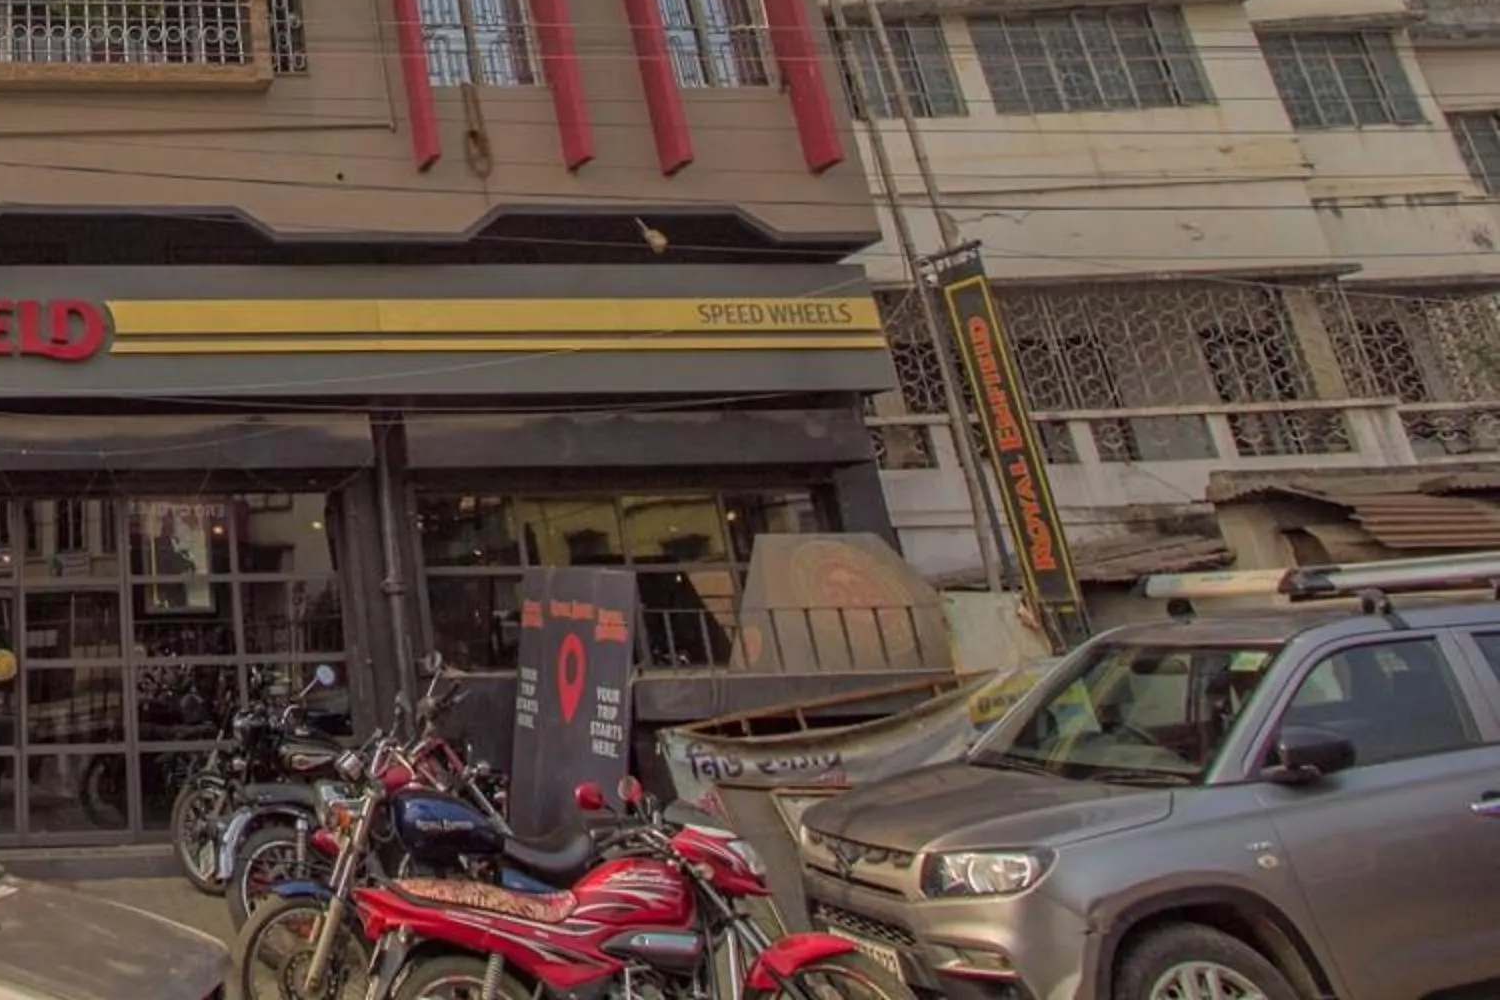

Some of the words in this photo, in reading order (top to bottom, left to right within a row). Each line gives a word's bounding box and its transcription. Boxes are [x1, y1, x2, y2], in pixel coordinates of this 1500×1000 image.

[697, 303, 763, 324] SPEED
[767, 303, 853, 324] WHEELS
[967, 314, 1024, 451] ENFIELD
[1009, 455, 1057, 570] ROYAL
[596, 686, 621, 704] YOUR
[597, 705, 618, 721] TRIP
[590, 721, 623, 741] STARTS
